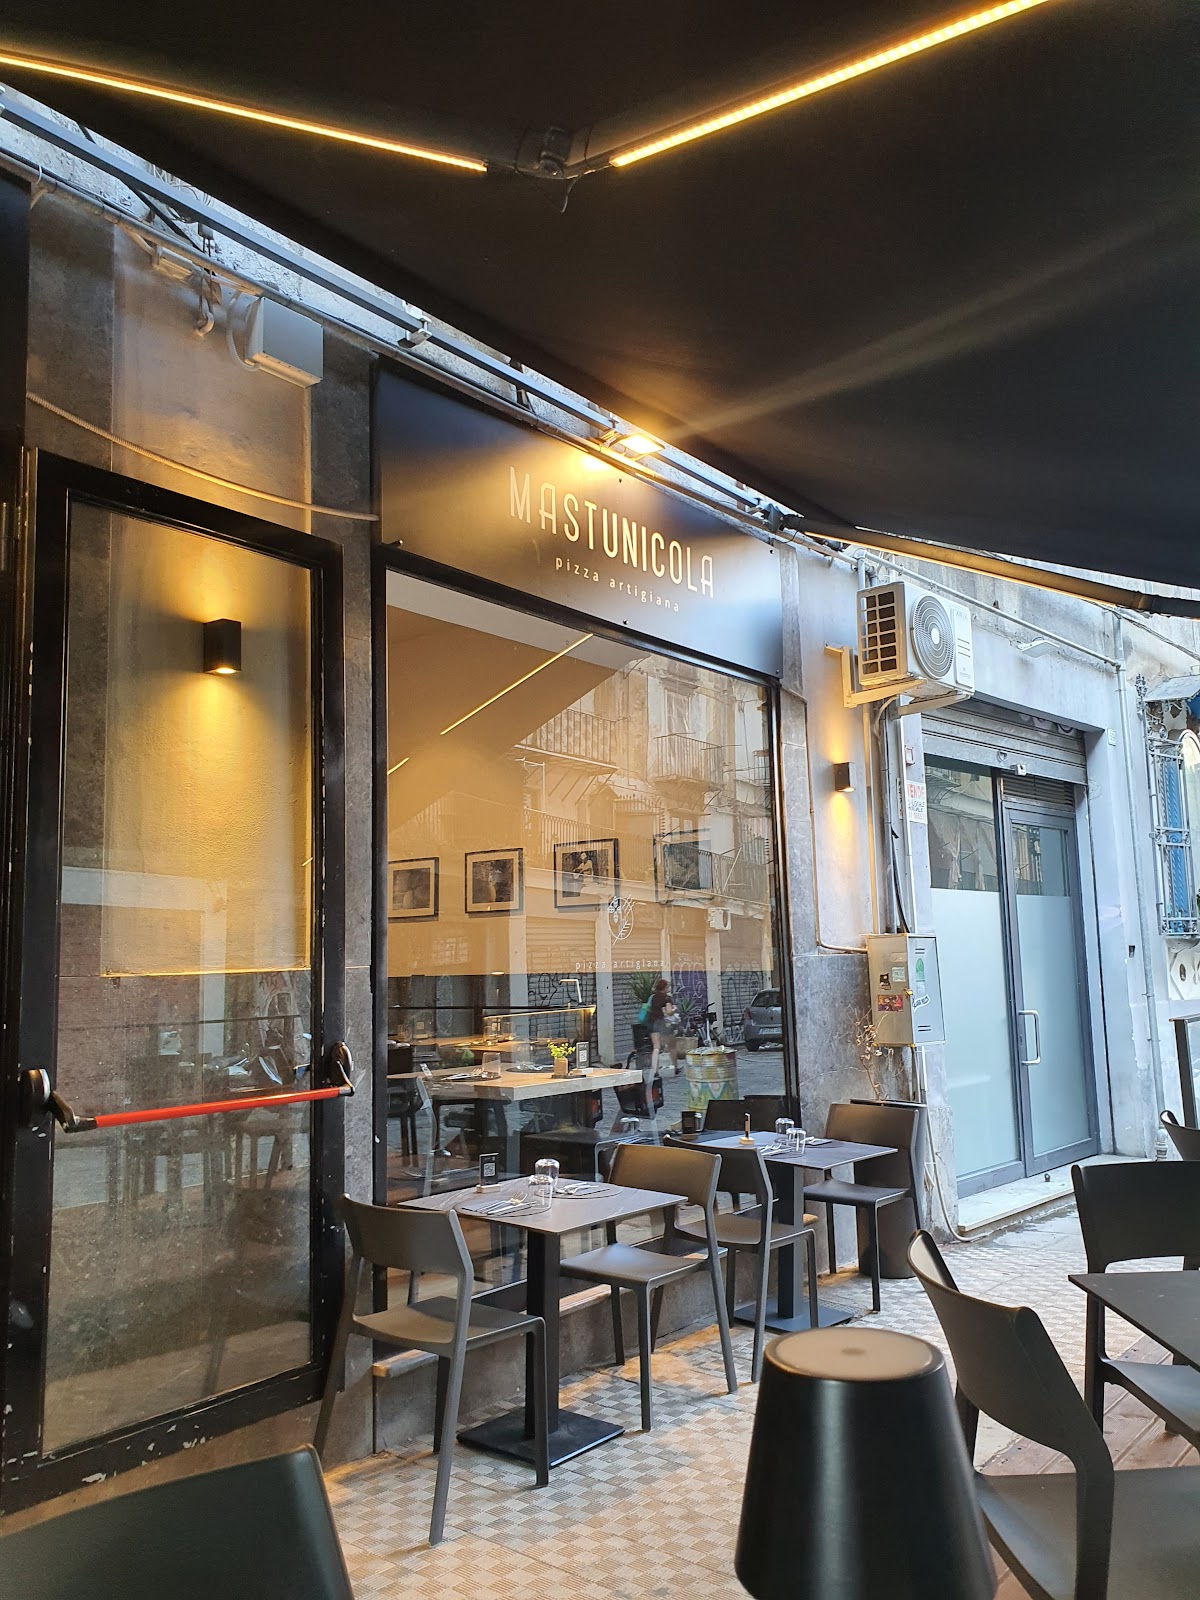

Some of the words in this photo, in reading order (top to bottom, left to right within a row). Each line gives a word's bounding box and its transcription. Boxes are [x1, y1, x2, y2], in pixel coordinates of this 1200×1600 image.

[509, 465, 714, 599] MASTUNICOLA
[555, 556, 599, 583] pizza
[609, 577, 679, 613] artigiana
[575, 961, 606, 973] pizza
[613, 958, 665, 970] artigiana
